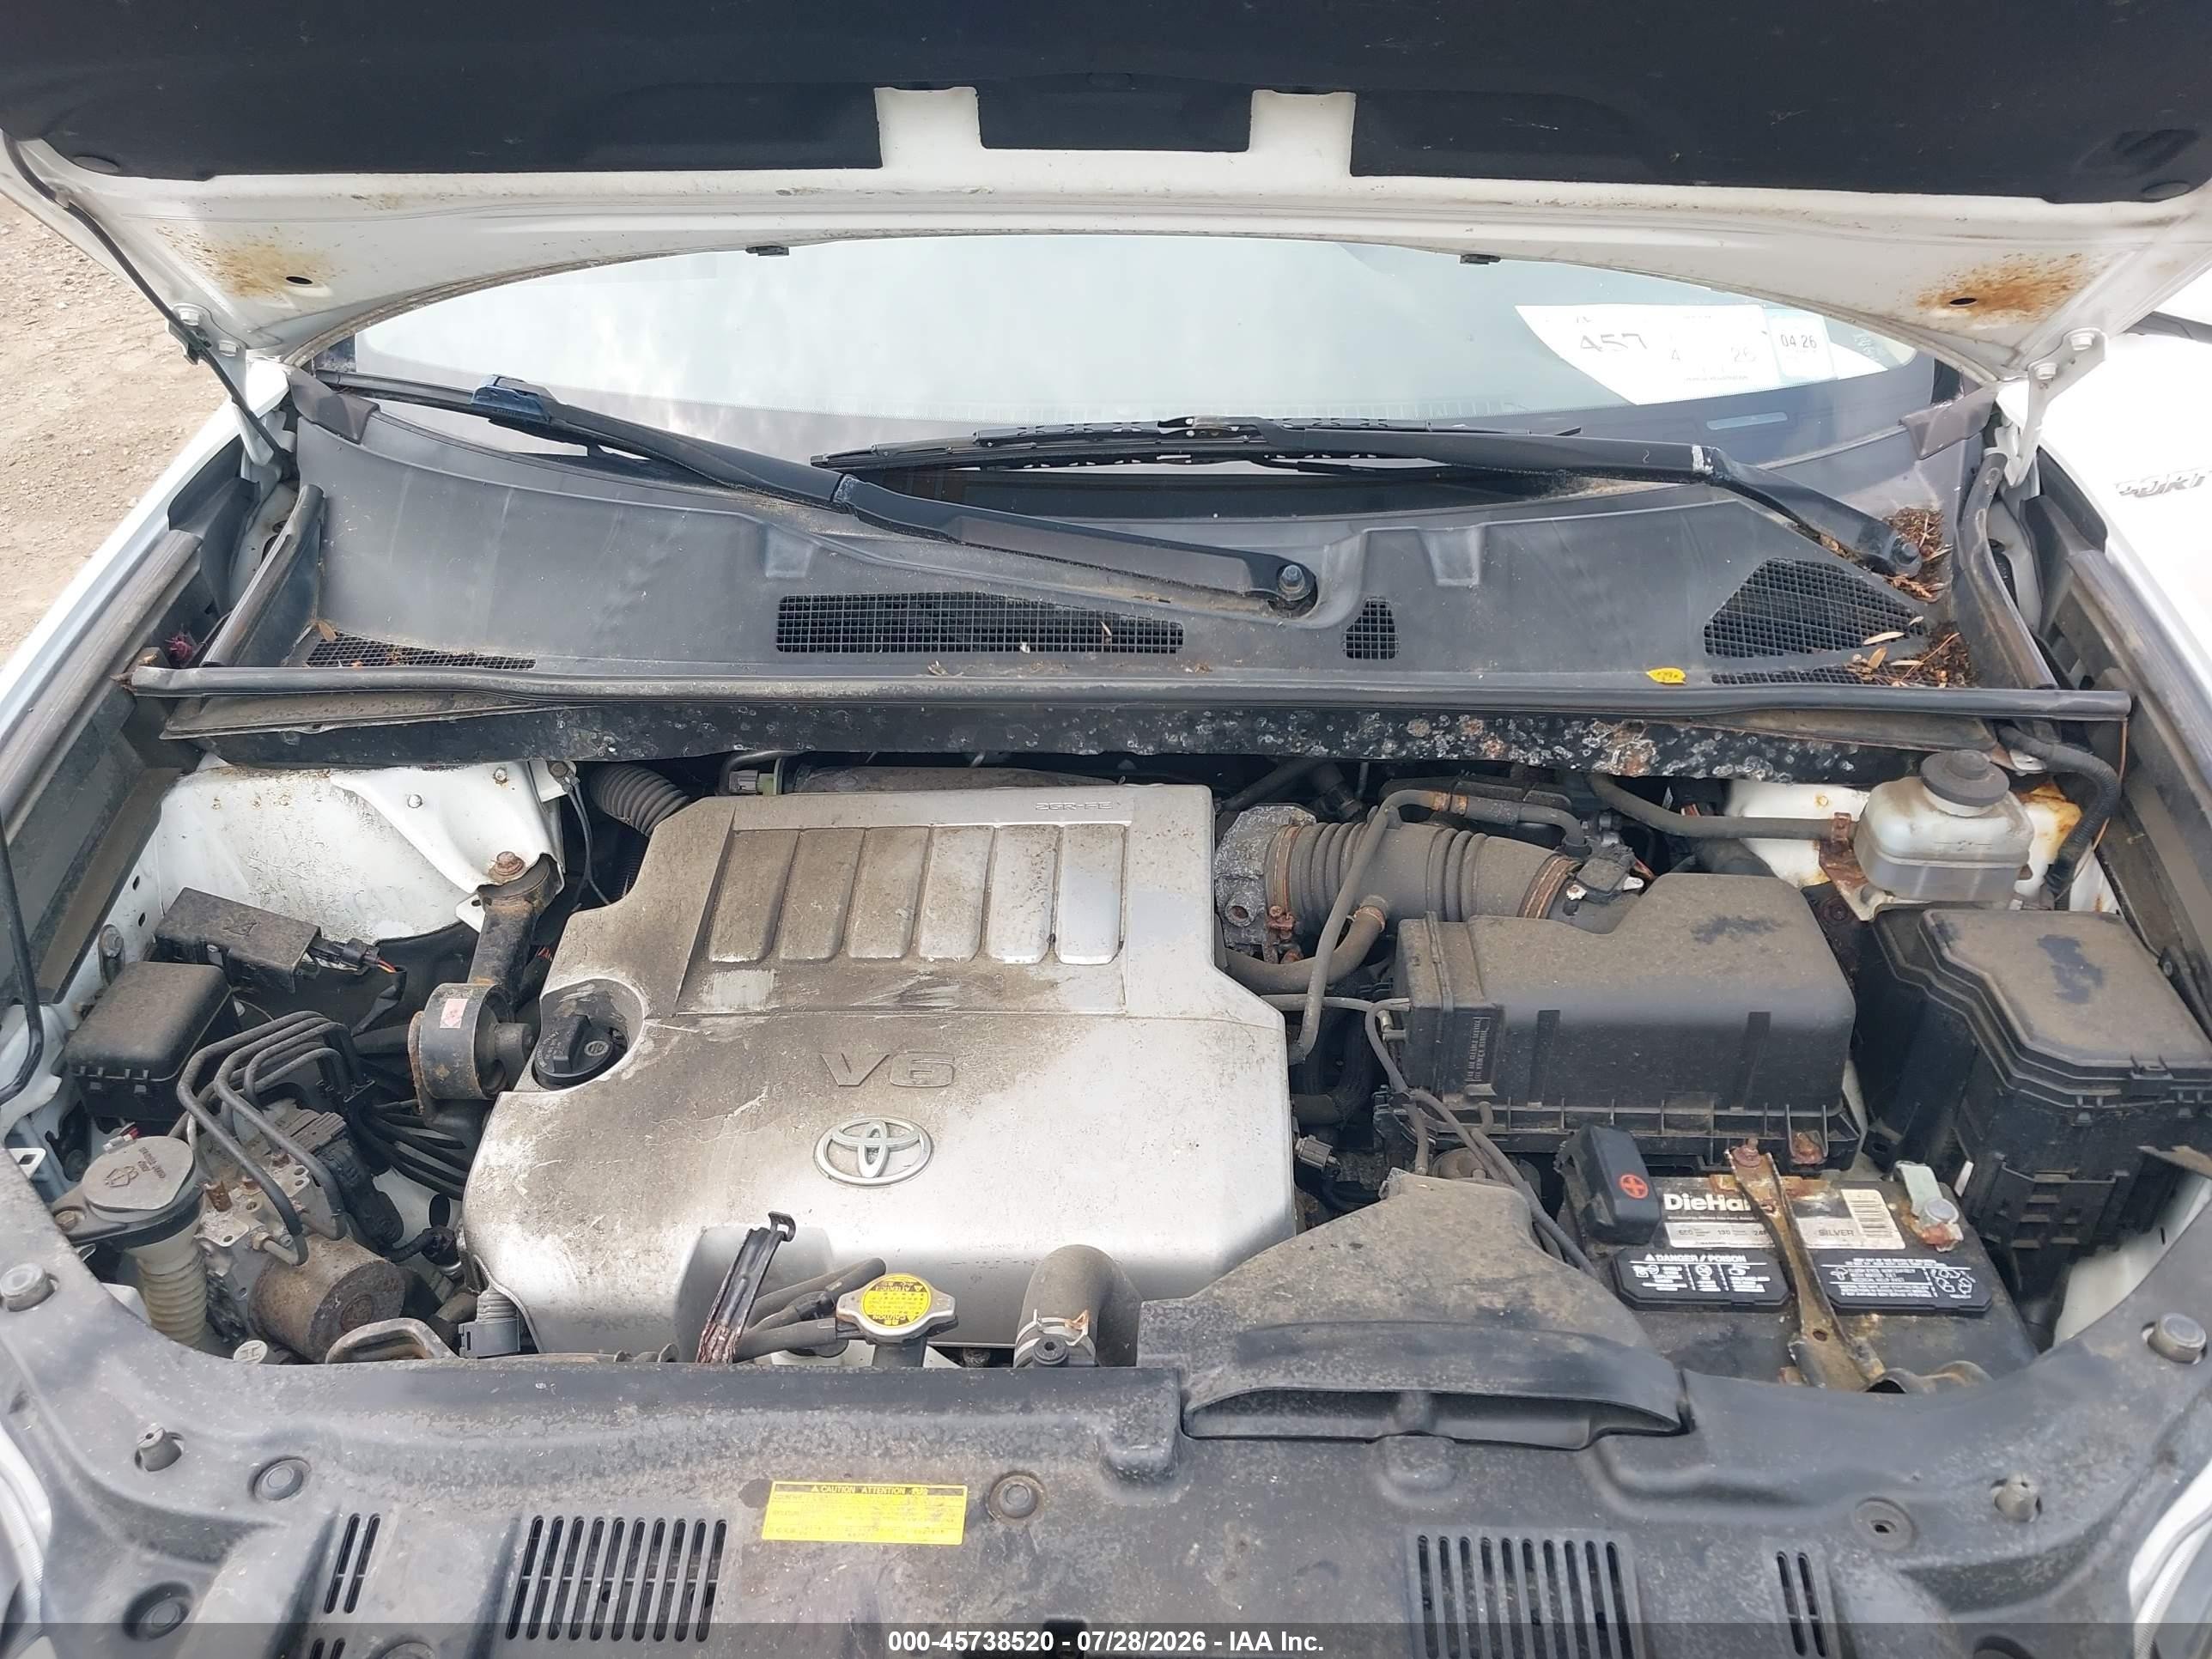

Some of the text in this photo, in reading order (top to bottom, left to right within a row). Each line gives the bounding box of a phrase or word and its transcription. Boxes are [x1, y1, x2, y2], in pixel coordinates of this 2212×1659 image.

[1780, 333, 1818, 349] 04 26
[819, 1050, 956, 1089] V6
[1819, 1229, 1855, 1237] SILVER
[1707, 1255, 1747, 1263] POISON
[820, 1486, 906, 1495] CAUTION ATTENTION
